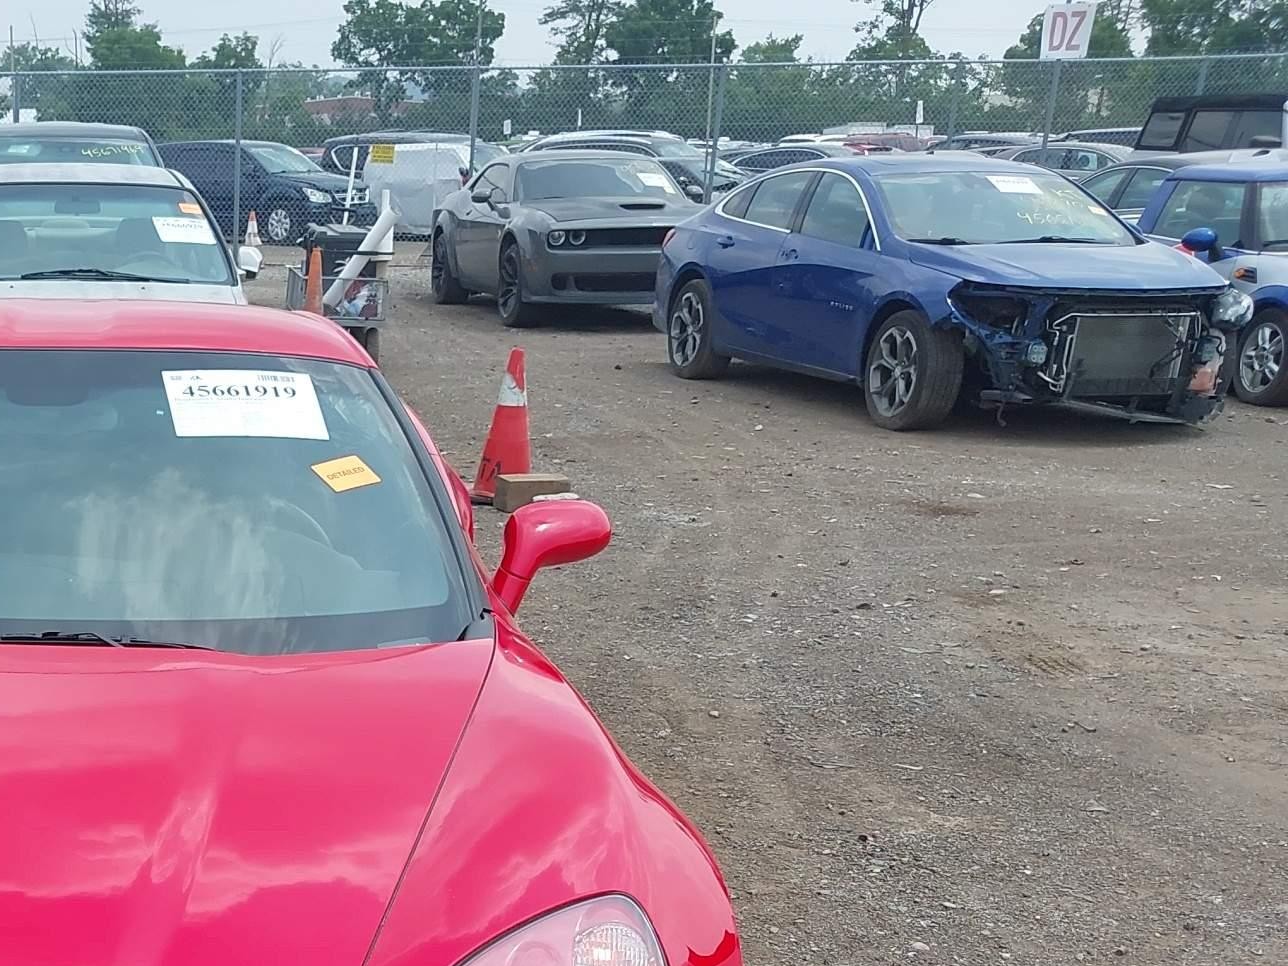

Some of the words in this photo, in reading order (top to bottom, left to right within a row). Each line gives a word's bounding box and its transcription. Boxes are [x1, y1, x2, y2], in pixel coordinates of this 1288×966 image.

[1048, 10, 1087, 52] DZ
[182, 384, 297, 398] 45661919
[326, 466, 365, 481] DETAILED
